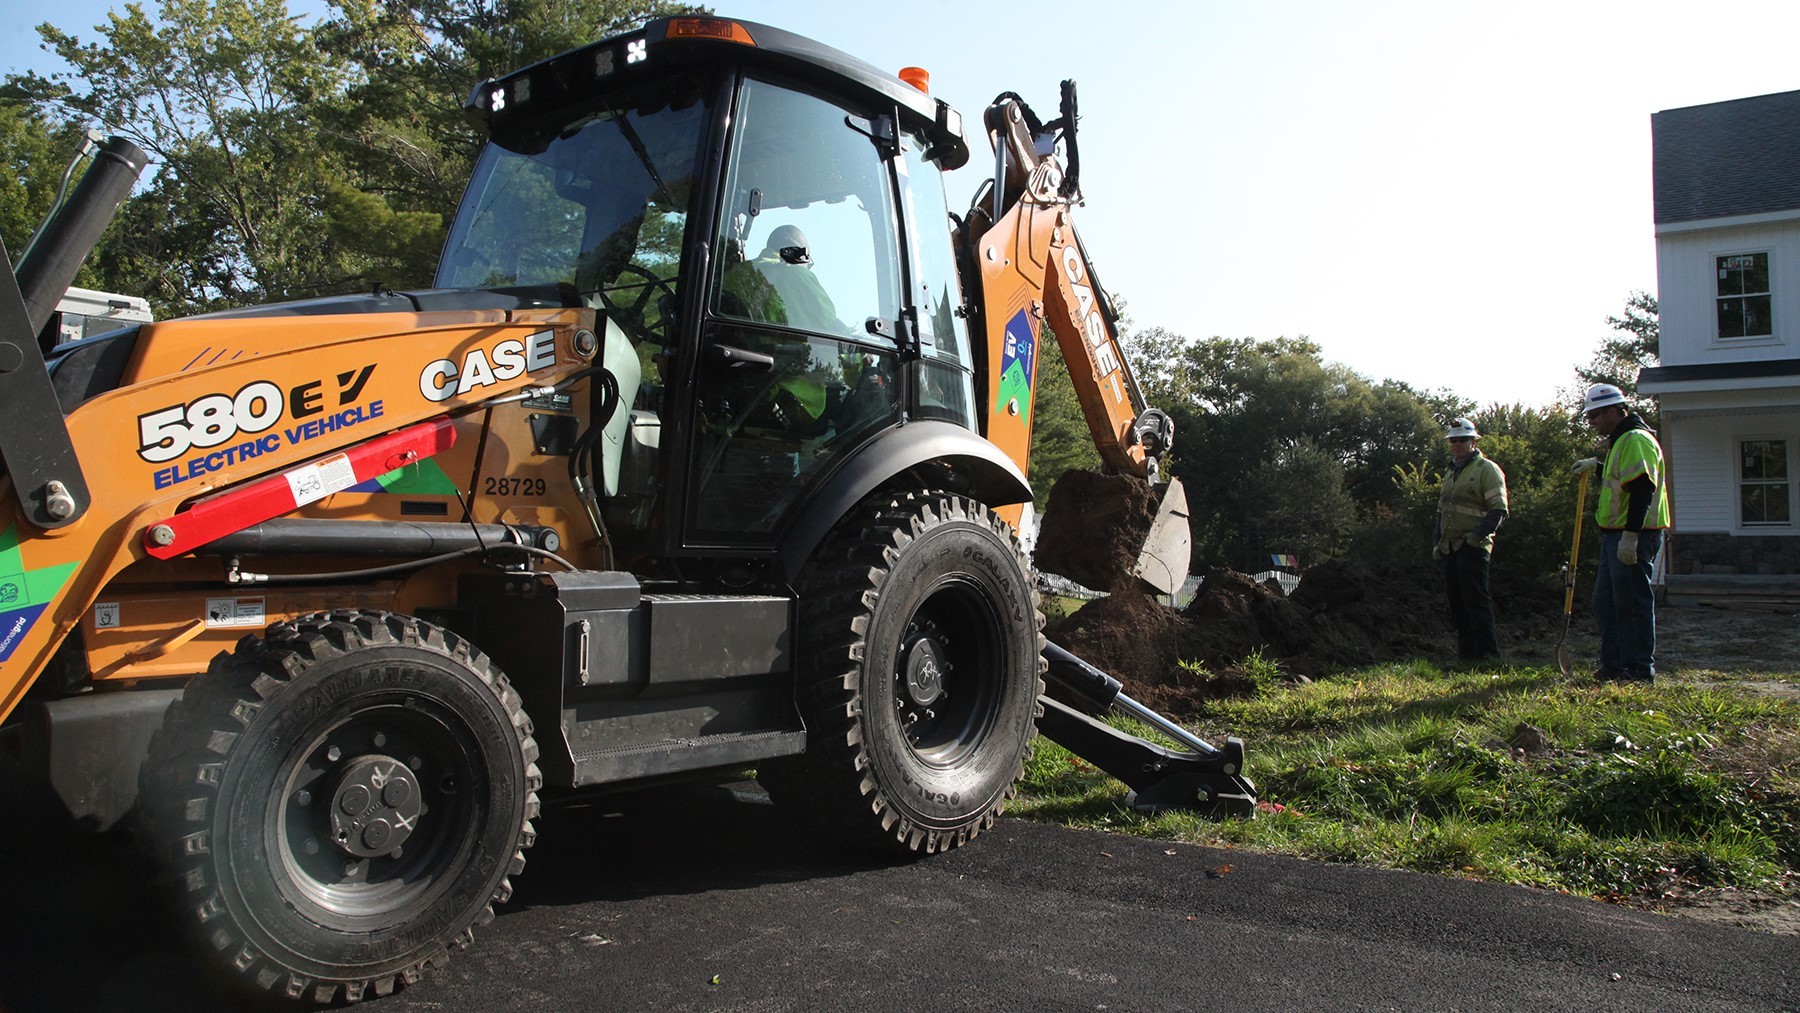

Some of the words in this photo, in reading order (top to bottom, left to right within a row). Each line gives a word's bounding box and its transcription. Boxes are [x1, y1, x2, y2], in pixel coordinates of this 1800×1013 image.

[1062, 245, 1119, 379] CASE
[419, 328, 557, 402] CASE
[136, 380, 284, 464] 580
[289, 363, 378, 420] EV
[153, 431, 281, 491] ELECTRIC
[284, 400, 384, 445] VEHICLE
[485, 477, 547, 496] 28729
[972, 551, 1024, 623] GALAXY
[311, 667, 428, 714] ALLIANCE
